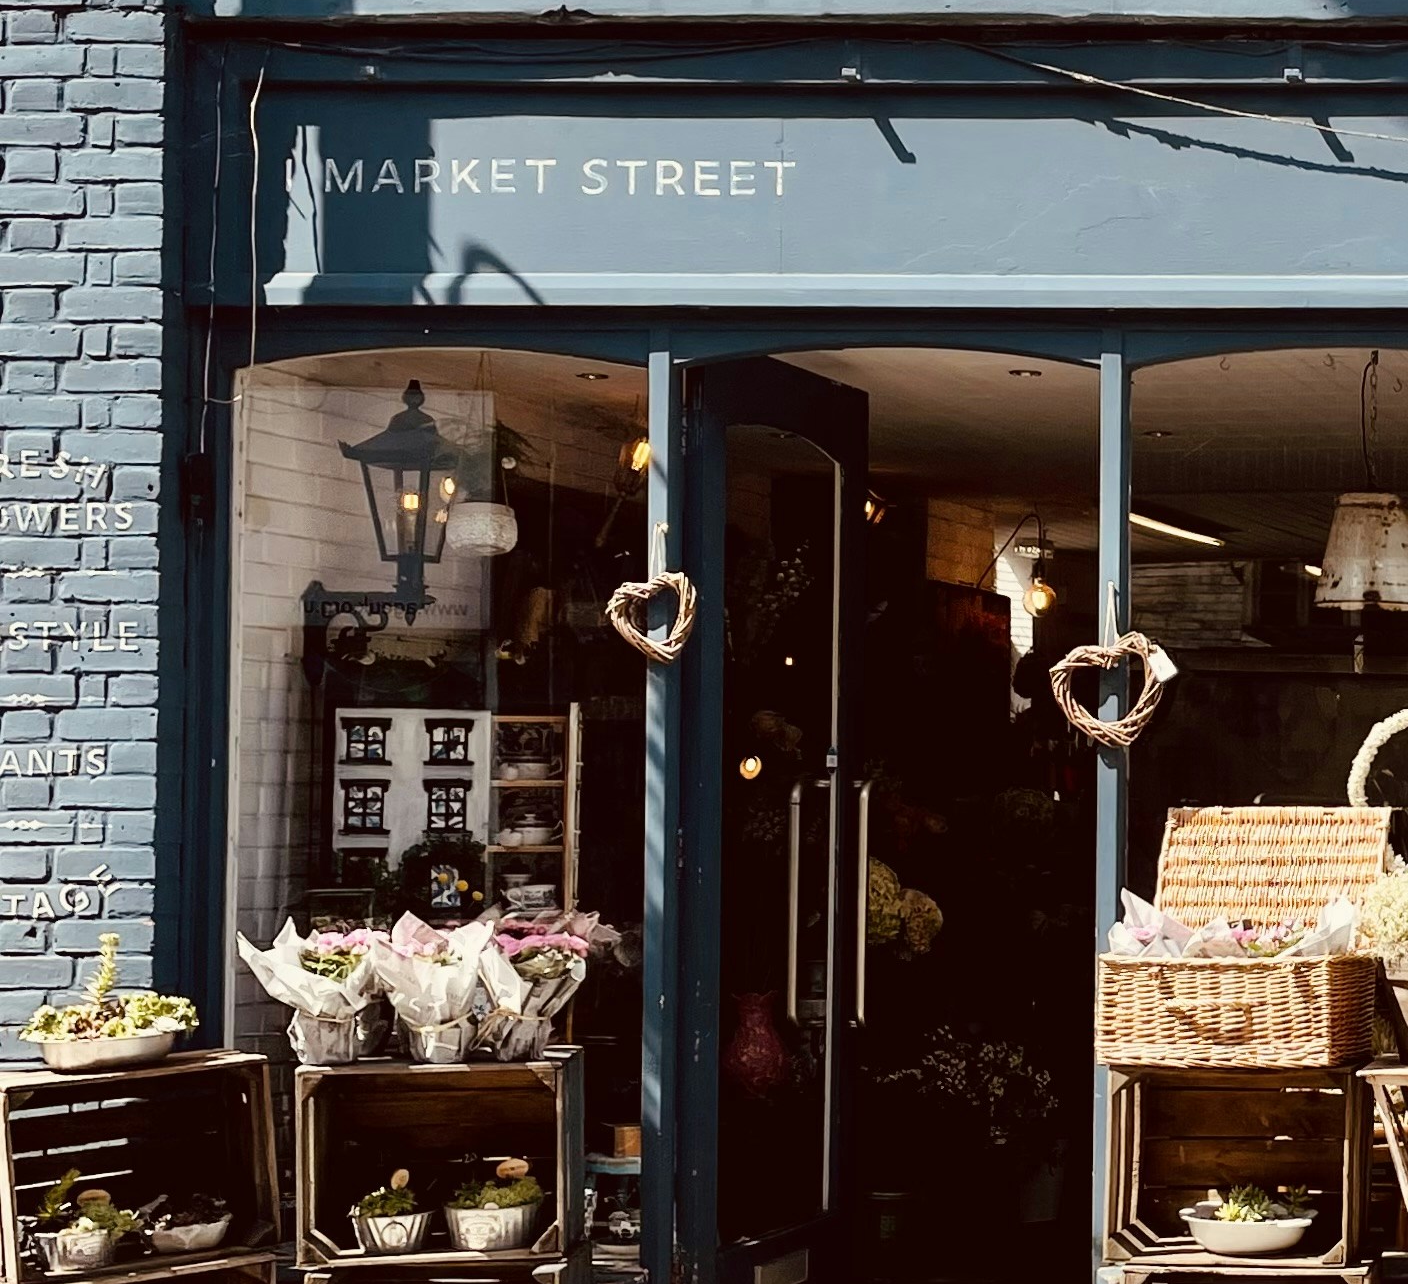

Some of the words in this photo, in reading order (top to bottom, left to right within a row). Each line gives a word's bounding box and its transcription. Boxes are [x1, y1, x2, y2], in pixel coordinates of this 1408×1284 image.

[323, 158, 557, 195] MARKET
[581, 158, 797, 197] STREET
[0, 621, 140, 652] STYLE
